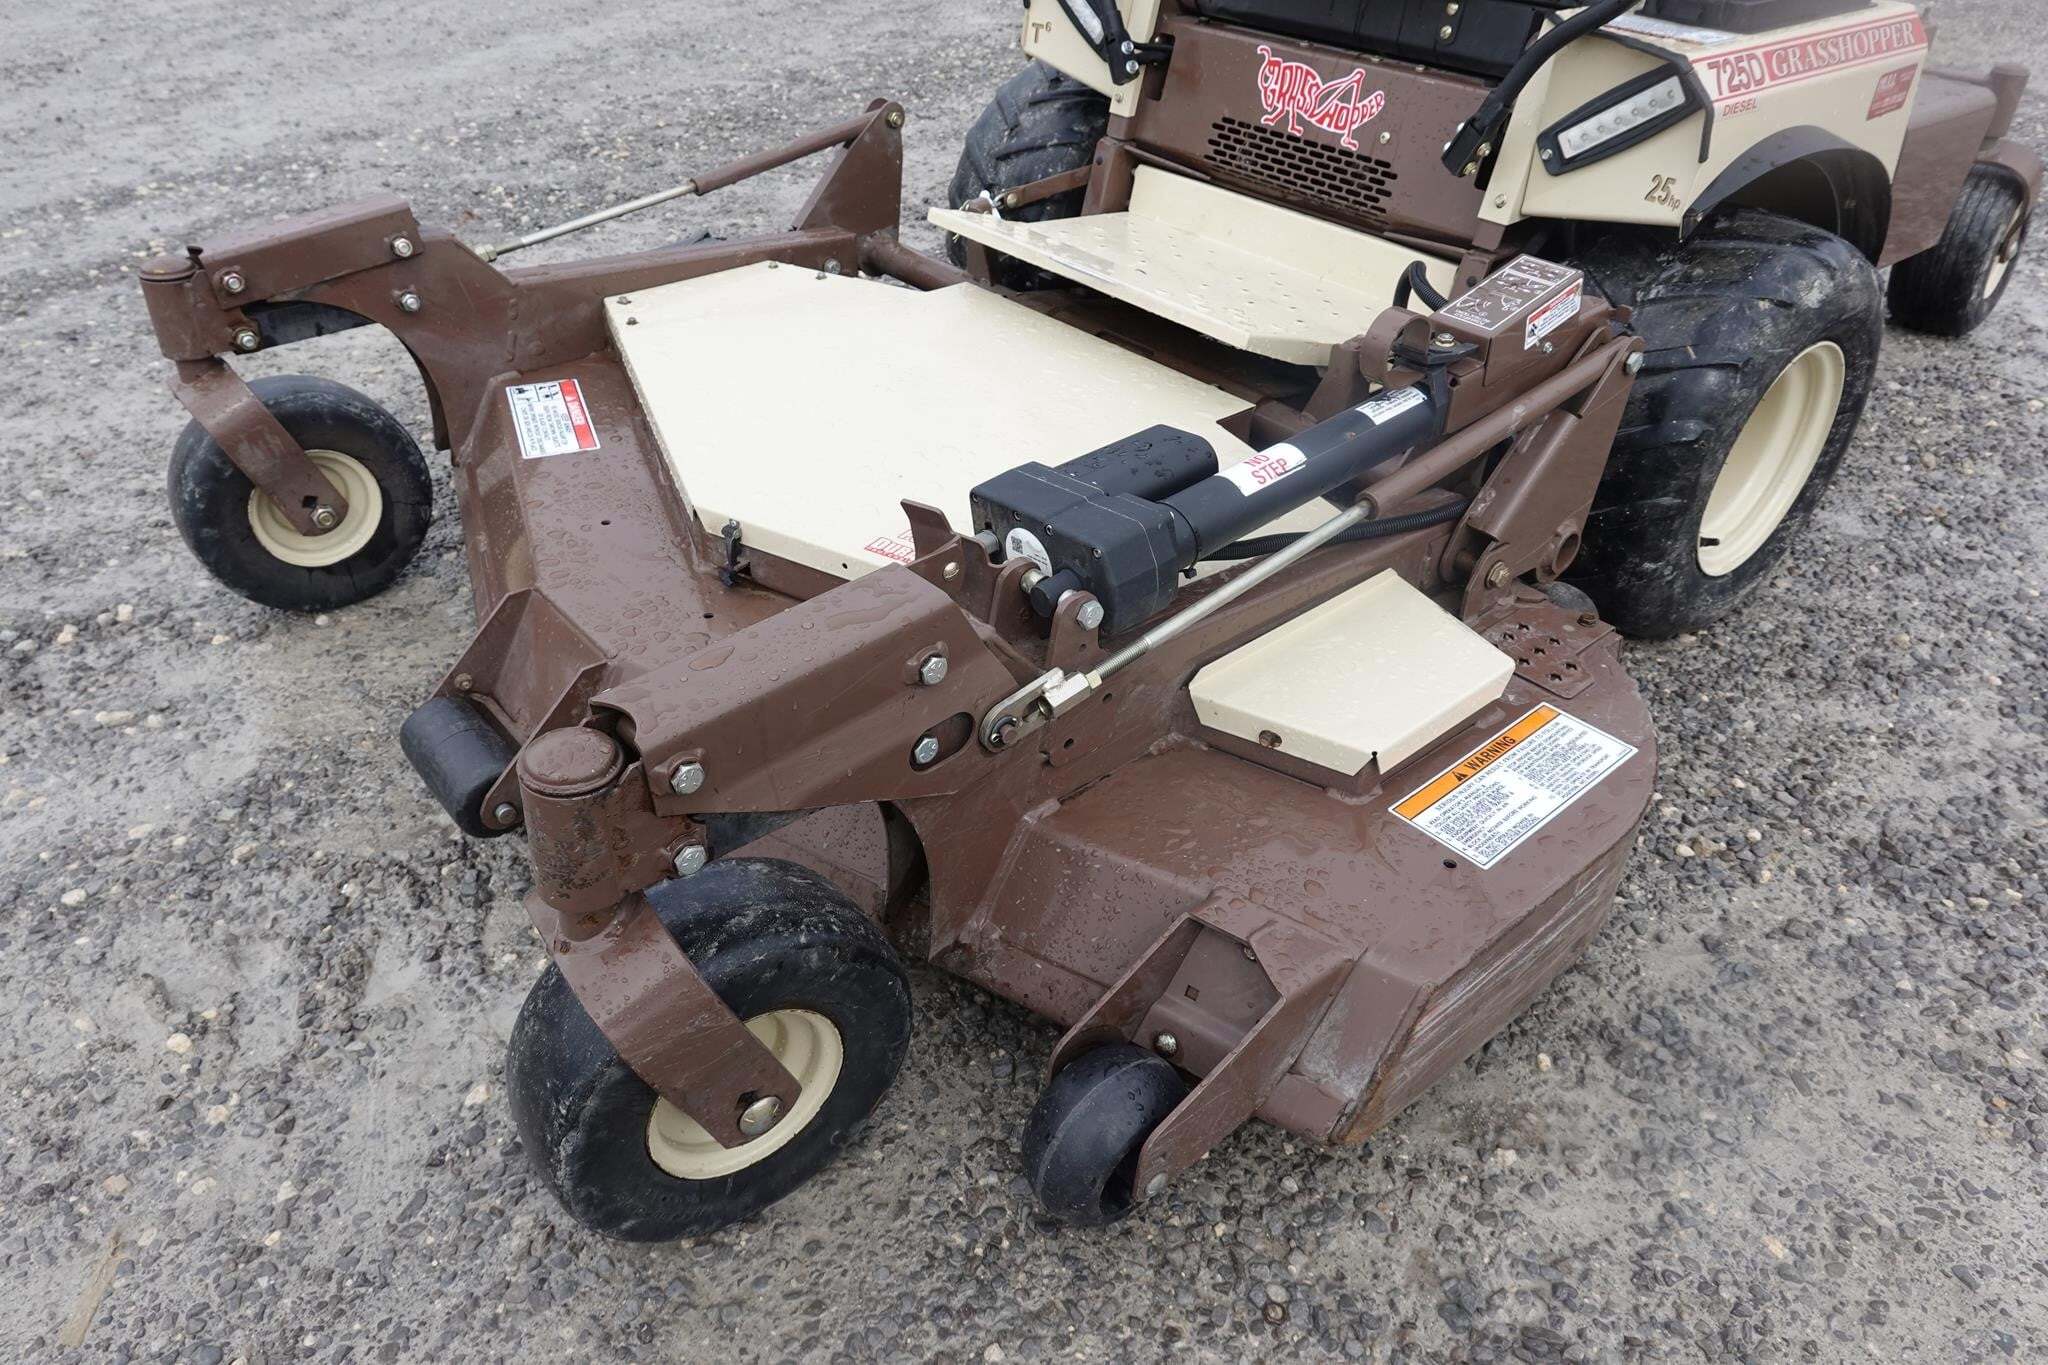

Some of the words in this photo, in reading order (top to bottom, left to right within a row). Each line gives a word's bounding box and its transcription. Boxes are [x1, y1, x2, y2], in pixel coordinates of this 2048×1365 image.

[1708, 51, 1768, 96] 725D
[1771, 19, 1917, 78] GRASSHOPPER
[1722, 98, 1758, 118] DIESEL
[1243, 453, 1271, 468] NO
[1251, 457, 1288, 485] STEP
[1465, 734, 1517, 771] WARNING
